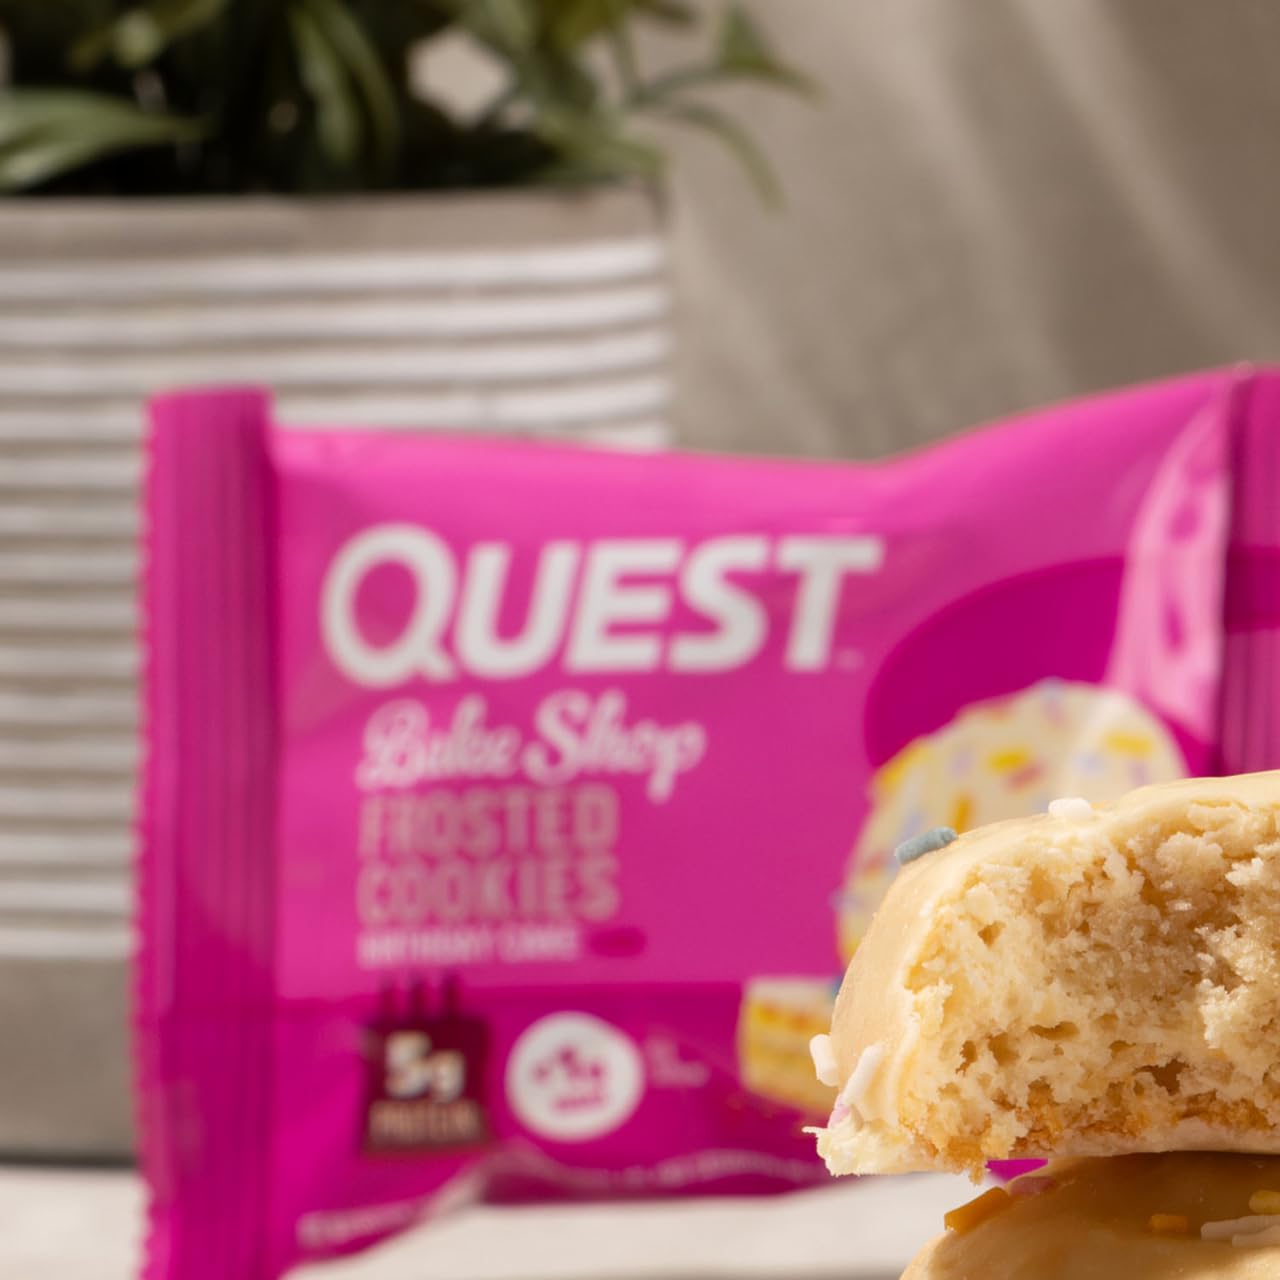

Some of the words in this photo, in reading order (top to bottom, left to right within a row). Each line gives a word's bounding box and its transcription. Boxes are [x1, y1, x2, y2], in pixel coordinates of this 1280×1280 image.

[322, 523, 884, 688] QUEST
[356, 694, 520, 789] Bake
[521, 690, 706, 803] Shop
[358, 785, 619, 859] FROSTED
[357, 857, 620, 922] COOKIES
